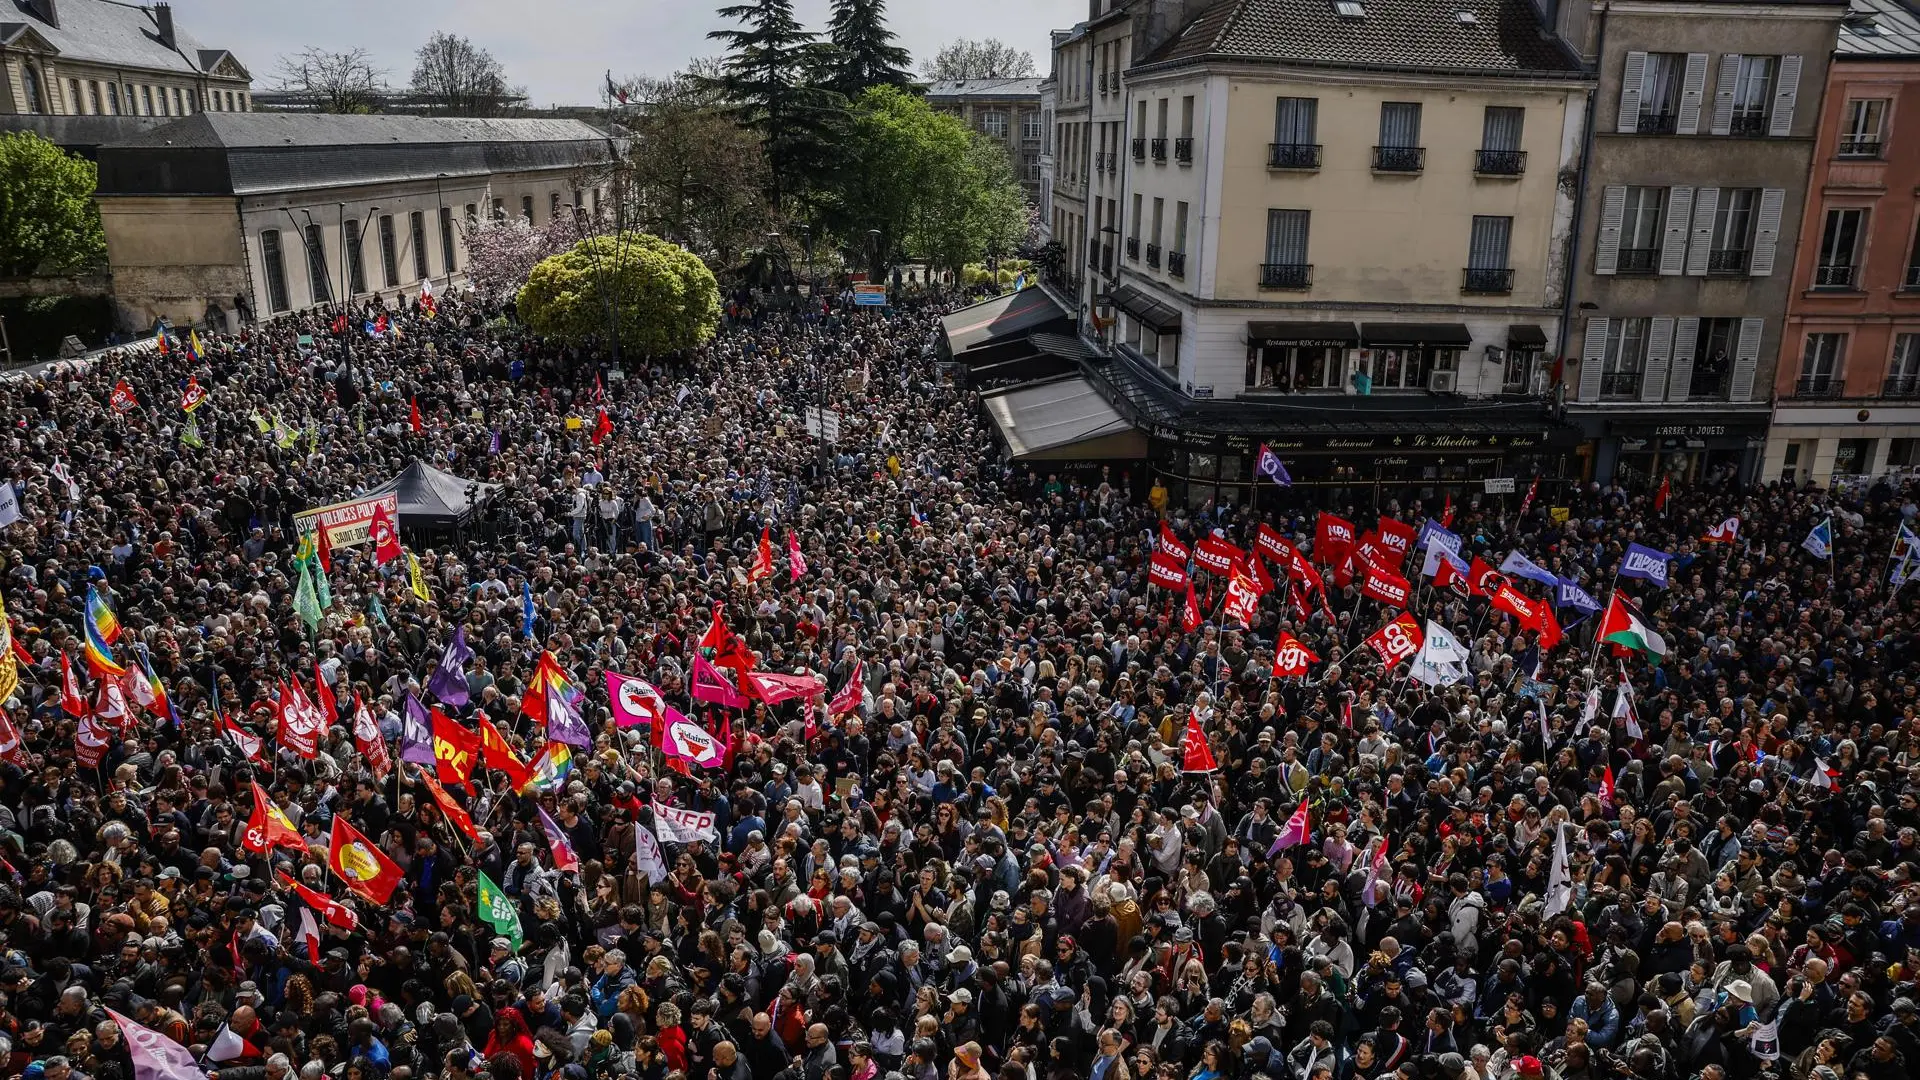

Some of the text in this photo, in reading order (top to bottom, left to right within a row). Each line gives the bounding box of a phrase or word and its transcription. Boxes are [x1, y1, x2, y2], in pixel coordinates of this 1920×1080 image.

[1655, 426, 1687, 435] L'ARBRE
[1696, 426, 1725, 435] JOUETS
[1266, 440, 1303, 448] Brasserie
[1326, 438, 1375, 447] Restaurant
[1412, 435, 1479, 447] Le Khedive
[1509, 437, 1534, 447] Tabac
[0, 497, 14, 512] me
[297, 517, 317, 533] STOP
[357, 496, 396, 519] POLICRES
[334, 525, 369, 544] SAINT-DEN
[1328, 524, 1351, 539] NPA
[1382, 531, 1406, 550] NPA
[1259, 532, 1290, 553] lutte
[1196, 547, 1231, 565] lutte
[1625, 552, 1667, 578] L'APRÈS
[1151, 561, 1183, 580] lutte
[1369, 575, 1405, 597] lutte
[1229, 580, 1257, 613] cgt
[1385, 623, 1416, 659] cgt
[1277, 649, 1309, 671] cgt
